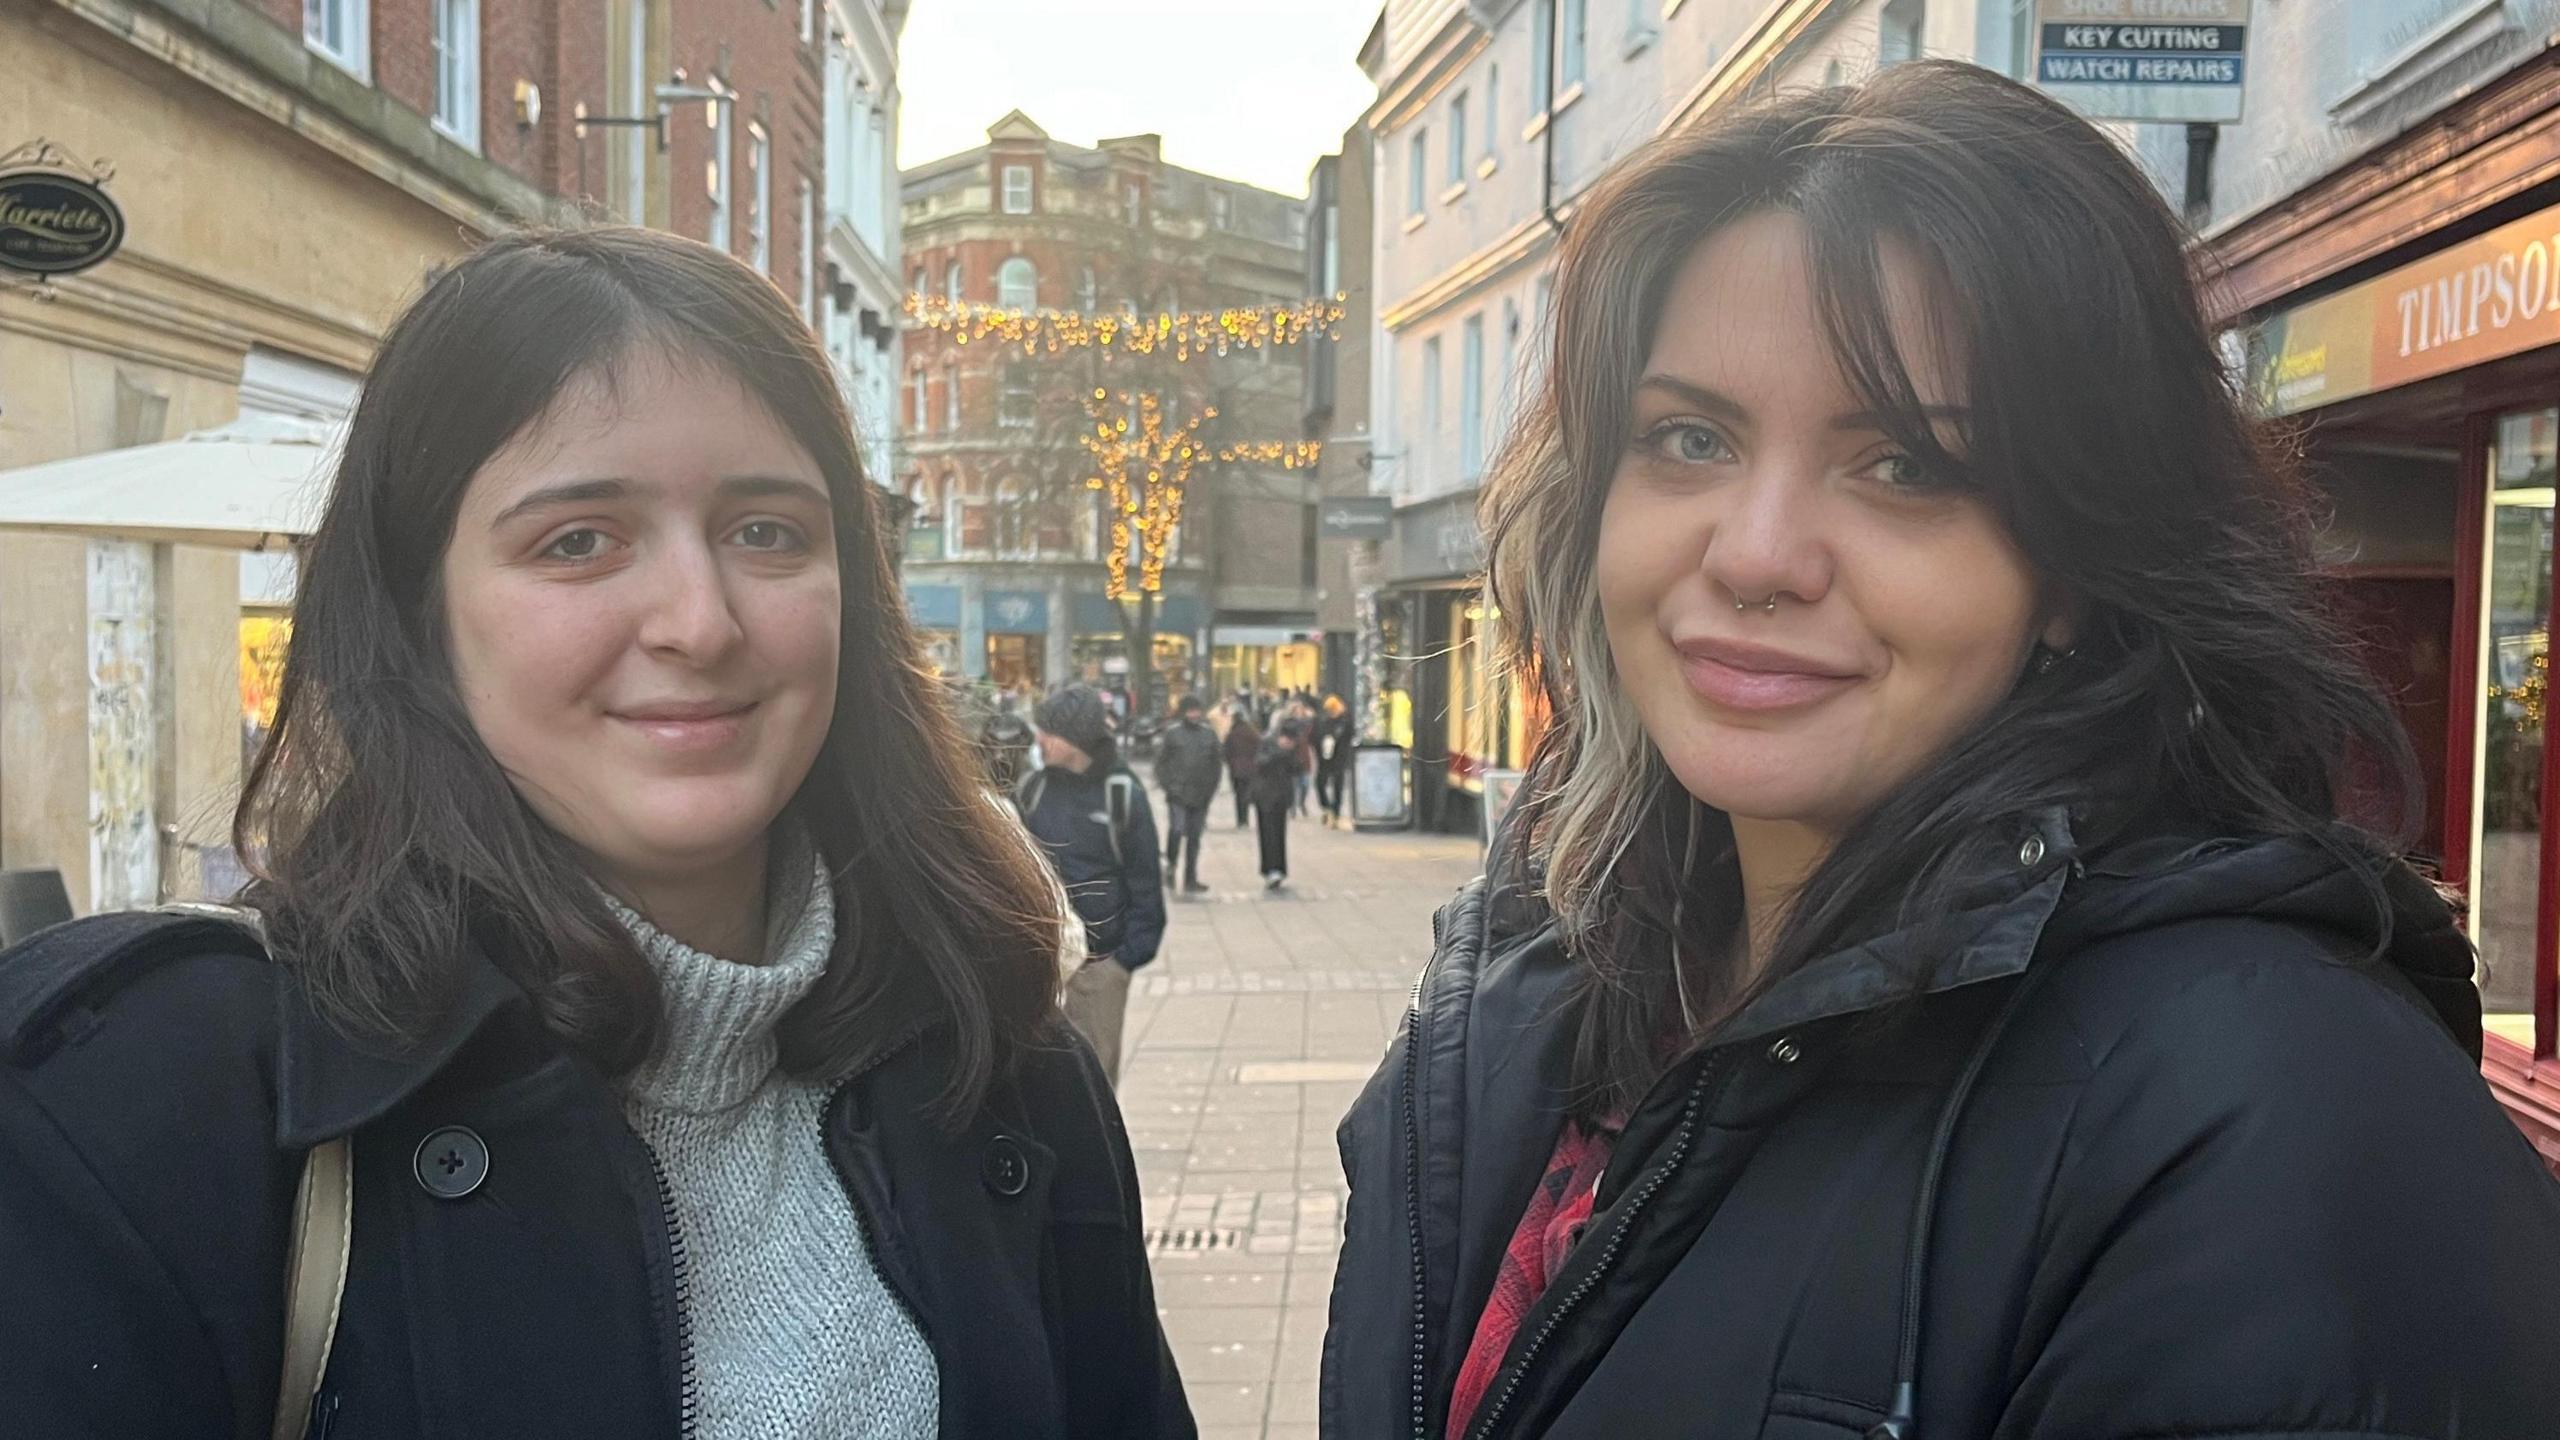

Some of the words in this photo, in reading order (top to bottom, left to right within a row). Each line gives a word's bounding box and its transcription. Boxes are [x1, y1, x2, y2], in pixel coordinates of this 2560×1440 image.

[2064, 26, 2113, 48] KEY
[2118, 27, 2220, 49] CUTTING
[2046, 58, 2130, 80] WATCH
[2136, 60, 2235, 82] REPAIRS
